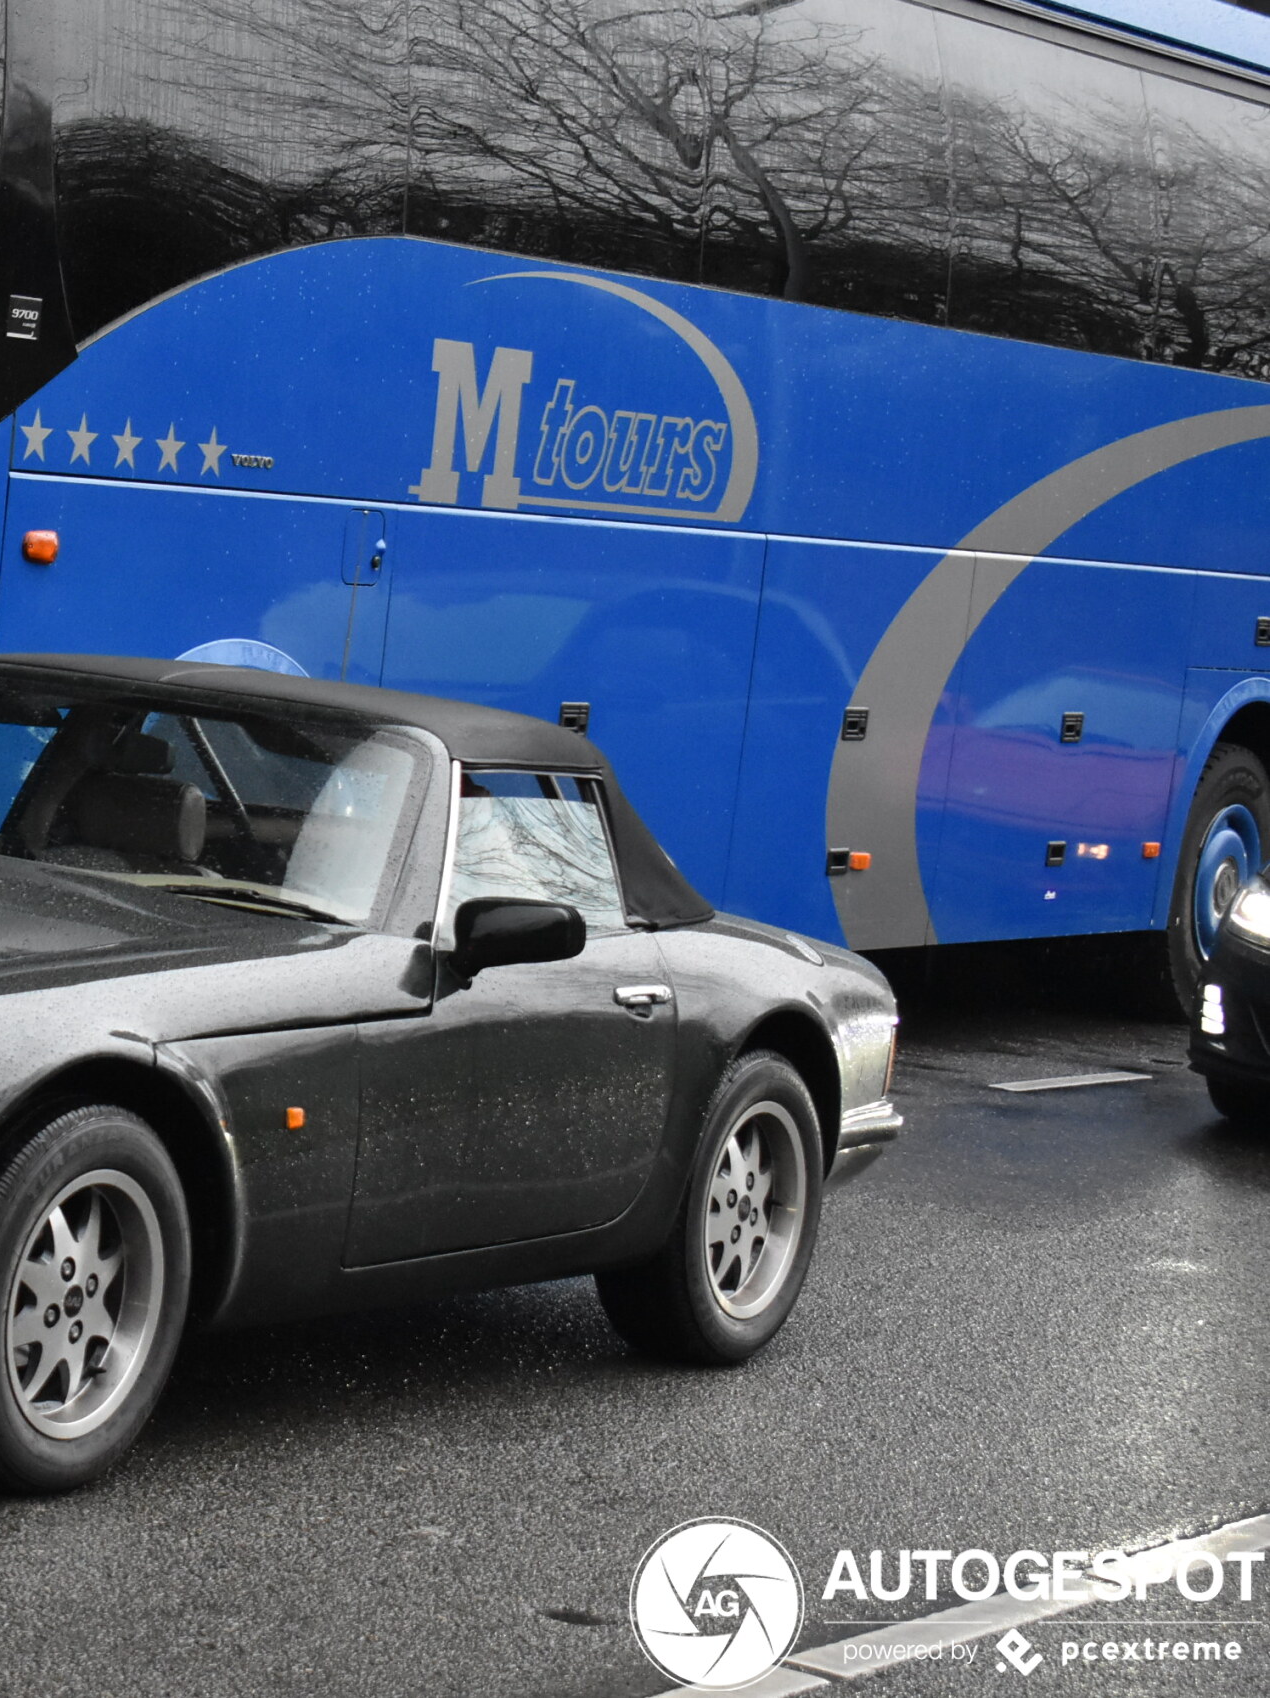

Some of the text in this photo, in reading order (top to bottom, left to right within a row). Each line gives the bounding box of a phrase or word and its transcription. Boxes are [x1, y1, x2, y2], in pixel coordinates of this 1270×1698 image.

[11, 308, 39, 321] 9700
[418, 337, 728, 510] M tours
[231, 453, 274, 469] VOLVO
